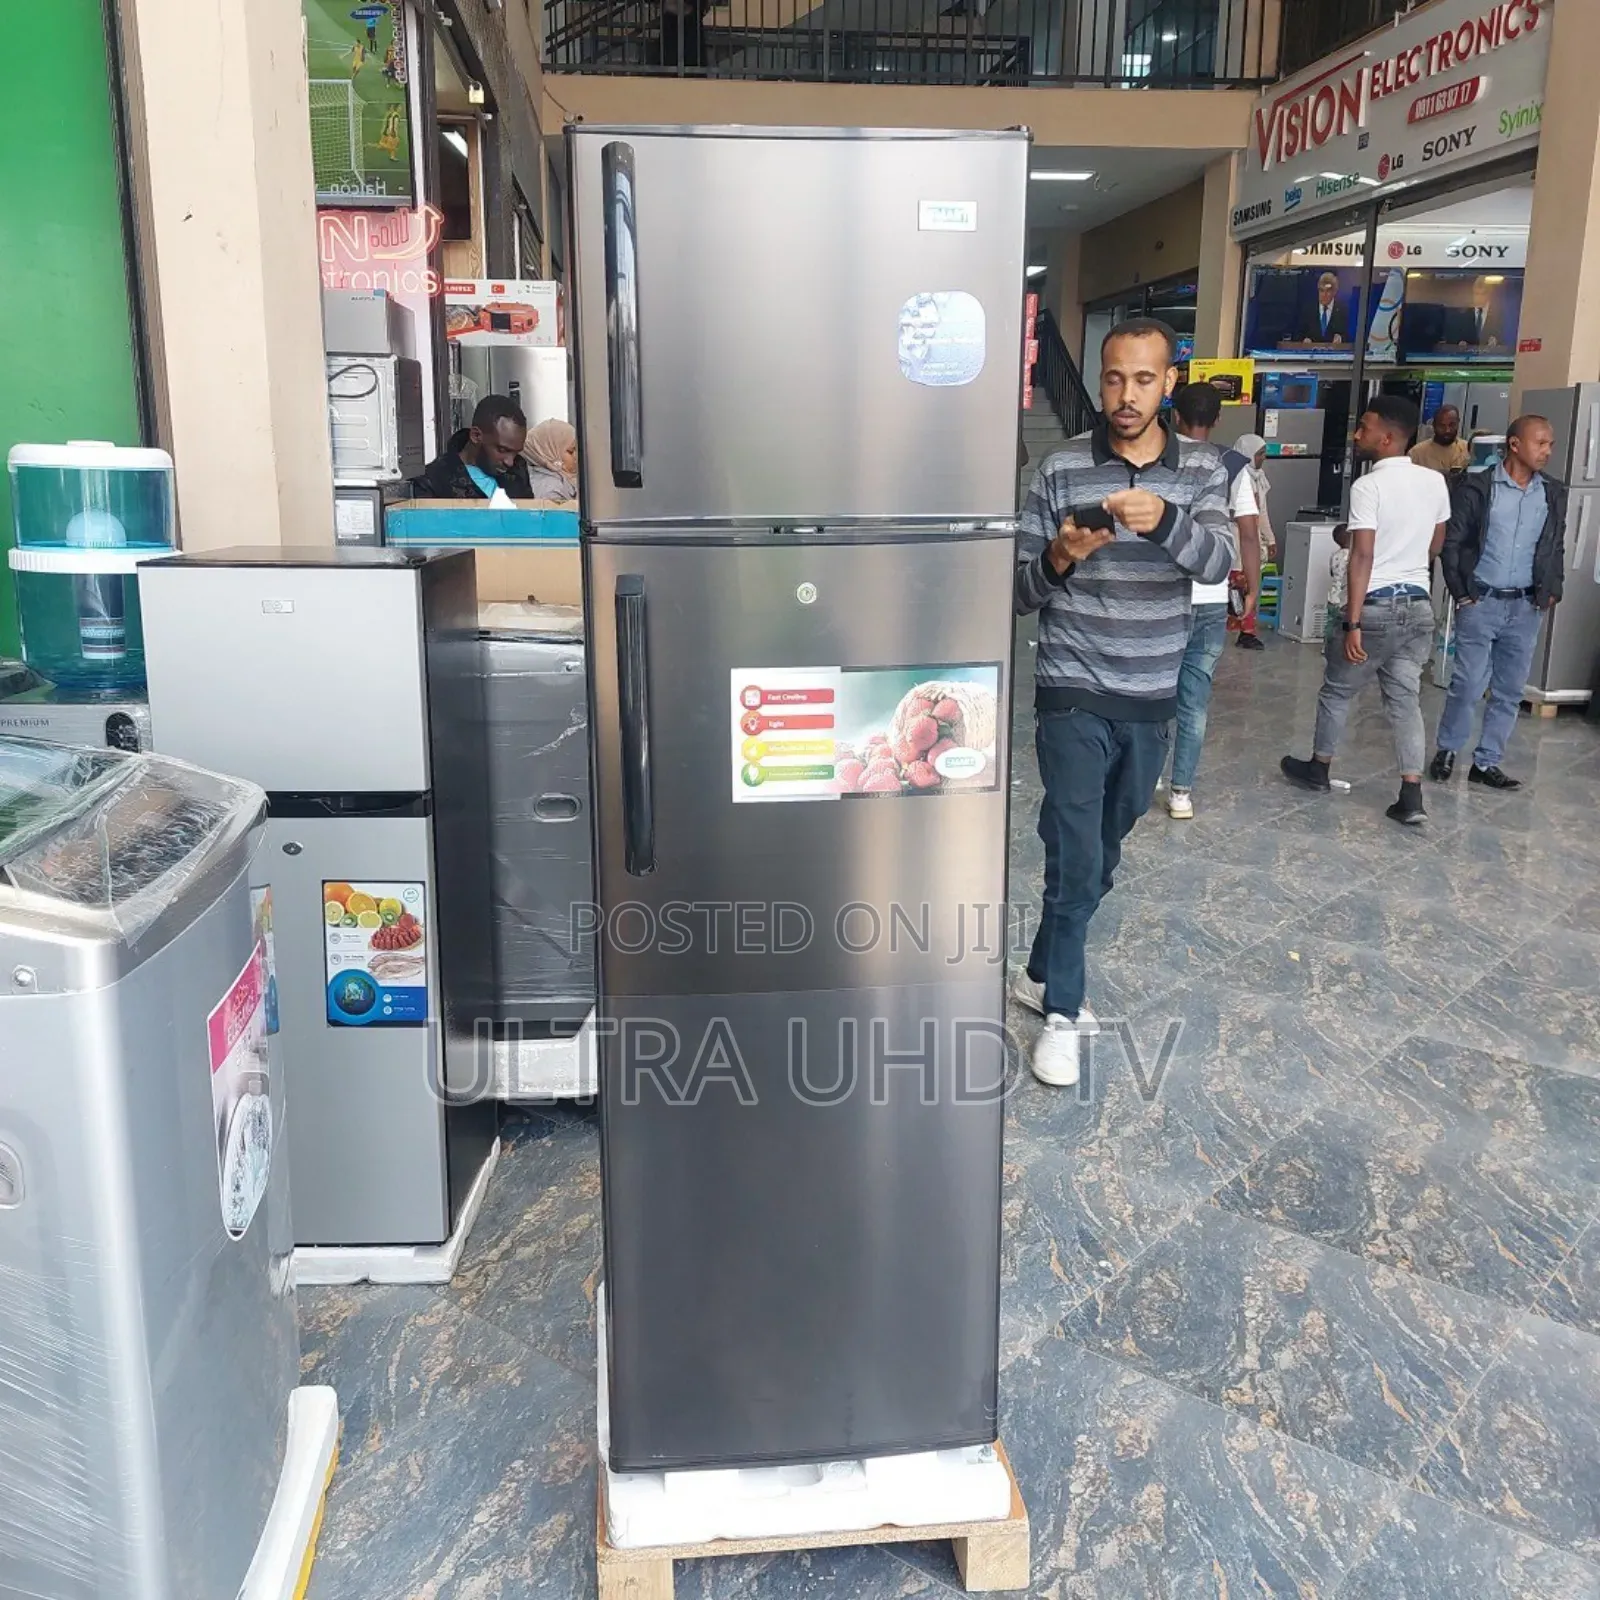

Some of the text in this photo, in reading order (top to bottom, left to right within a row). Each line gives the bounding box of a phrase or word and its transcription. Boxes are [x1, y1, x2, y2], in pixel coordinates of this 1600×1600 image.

[1256, 0, 1540, 170] VISION ELECTRONICS
[1233, 100, 1543, 226] SAMSUNG beko Hisense LG SONY Syinix
[1302, 243, 1510, 258] SAMSUN LG SONY
[321, 262, 439, 294] tronics
[0, 718, 50, 728] PREMIUM
